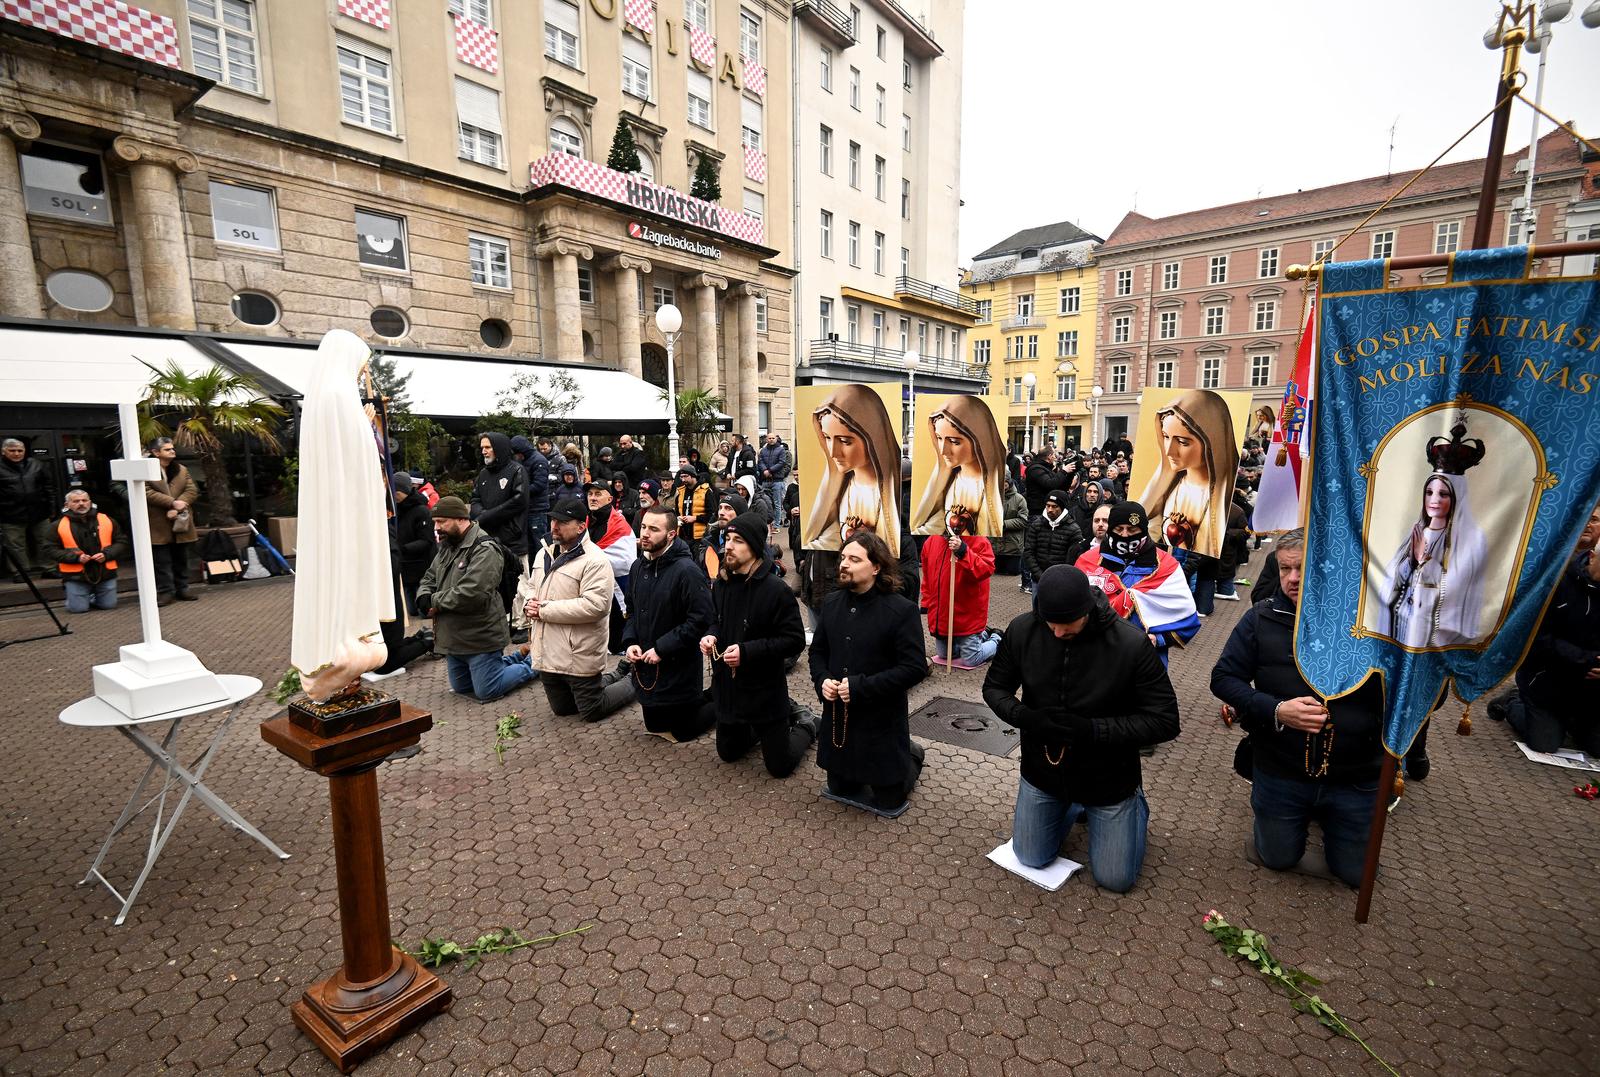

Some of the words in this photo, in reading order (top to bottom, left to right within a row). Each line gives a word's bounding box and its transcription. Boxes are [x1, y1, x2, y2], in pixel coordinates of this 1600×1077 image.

[51, 196, 86, 212] SOL
[626, 180, 721, 231] HRVATSKA
[233, 228, 260, 241] SOL
[642, 226, 696, 252] Zagrebačka
[697, 240, 722, 259] banka
[1333, 321, 1442, 366] GOSPA
[1358, 356, 1447, 394] MOLI
[1459, 354, 1503, 375] ZA
[1517, 357, 1599, 395] NAS
